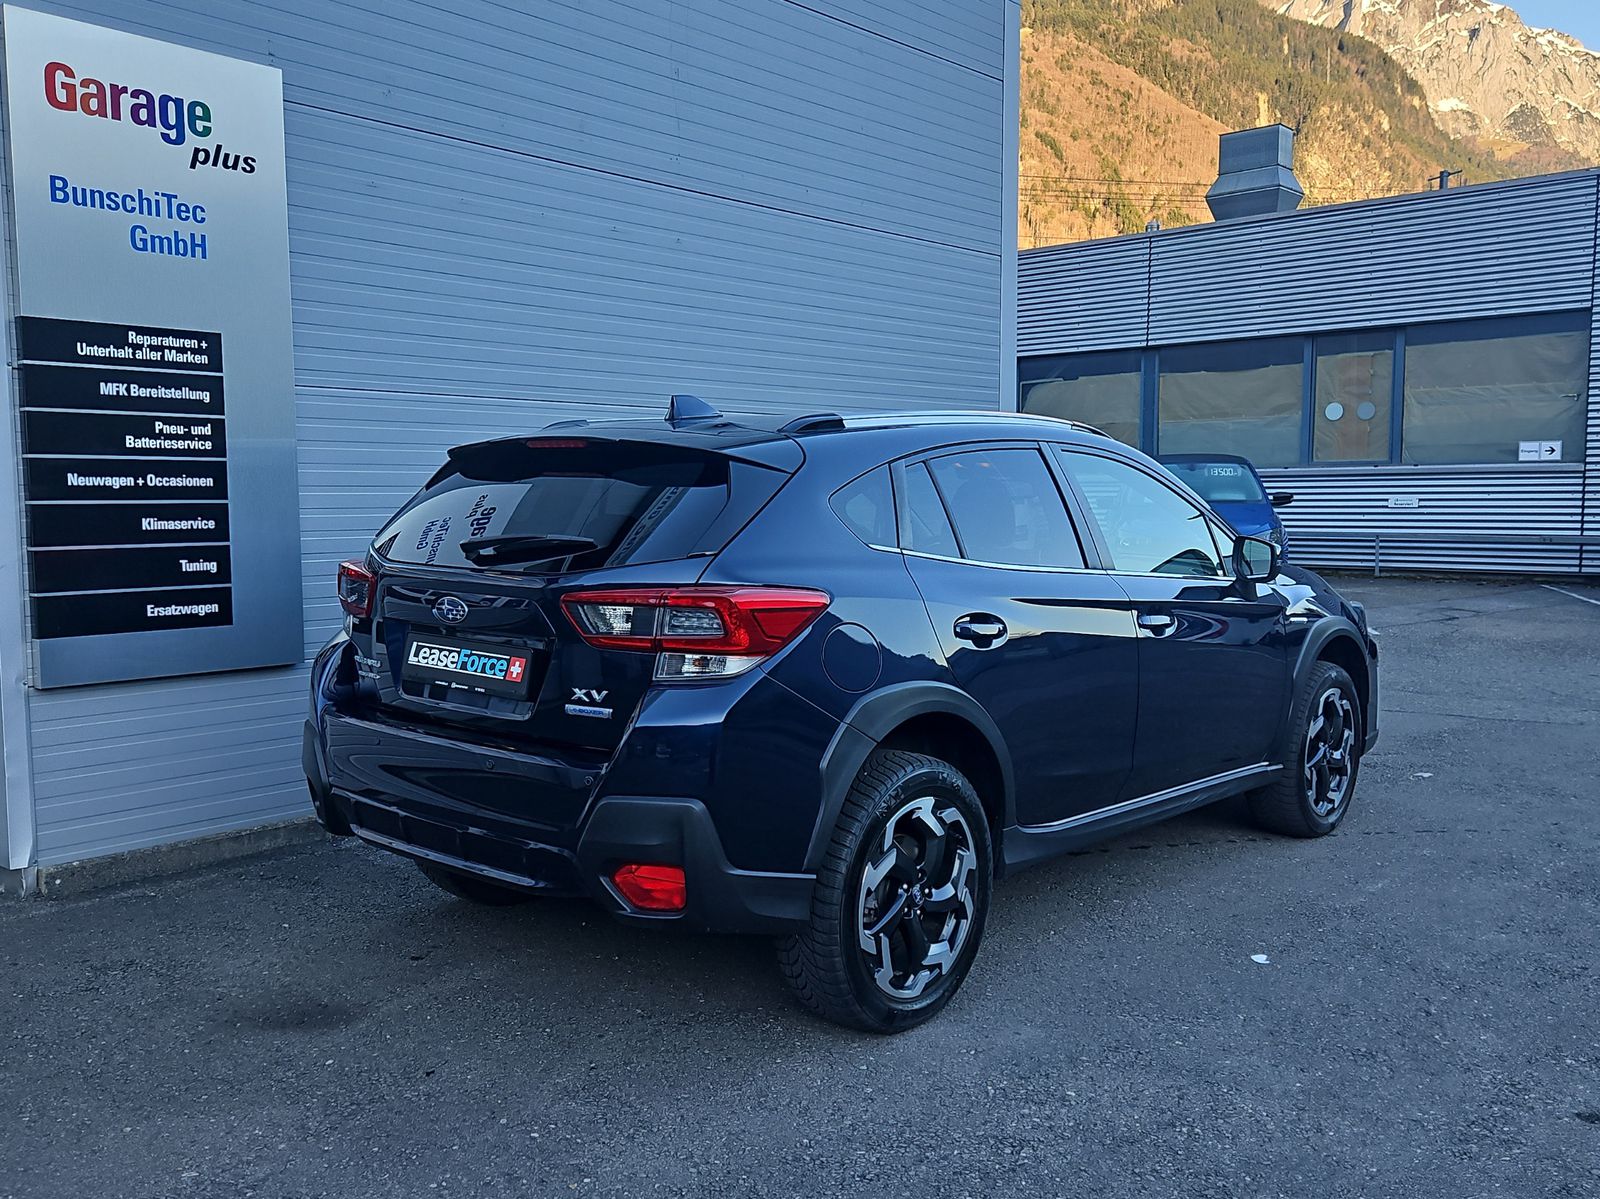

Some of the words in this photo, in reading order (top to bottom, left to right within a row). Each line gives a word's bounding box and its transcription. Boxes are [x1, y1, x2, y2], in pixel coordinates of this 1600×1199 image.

[44, 61, 212, 146] Garage
[189, 144, 257, 174] plus
[49, 175, 206, 224] BunschiTec
[129, 224, 208, 260] GmbH
[128, 331, 198, 348] Reparaturen
[200, 341, 208, 349] +
[77, 342, 133, 359] Unterhalt
[135, 348, 162, 361] aller
[164, 350, 209, 364] Marken
[100, 382, 128, 397] MFK
[130, 383, 210, 403] Bereitstellung
[155, 421, 188, 435] Pneu-
[191, 423, 212, 435] und
[125, 435, 212, 450] Batterieservice
[67, 472, 134, 489] Neuwagen
[136, 476, 145, 486] +
[146, 473, 214, 487] Occasionen
[141, 517, 216, 531] Klimaservice
[179, 558, 217, 573] Tuning
[147, 603, 219, 617] Ersatzwagen
[408, 641, 508, 678] LeaseForce
[571, 687, 609, 703] XV
